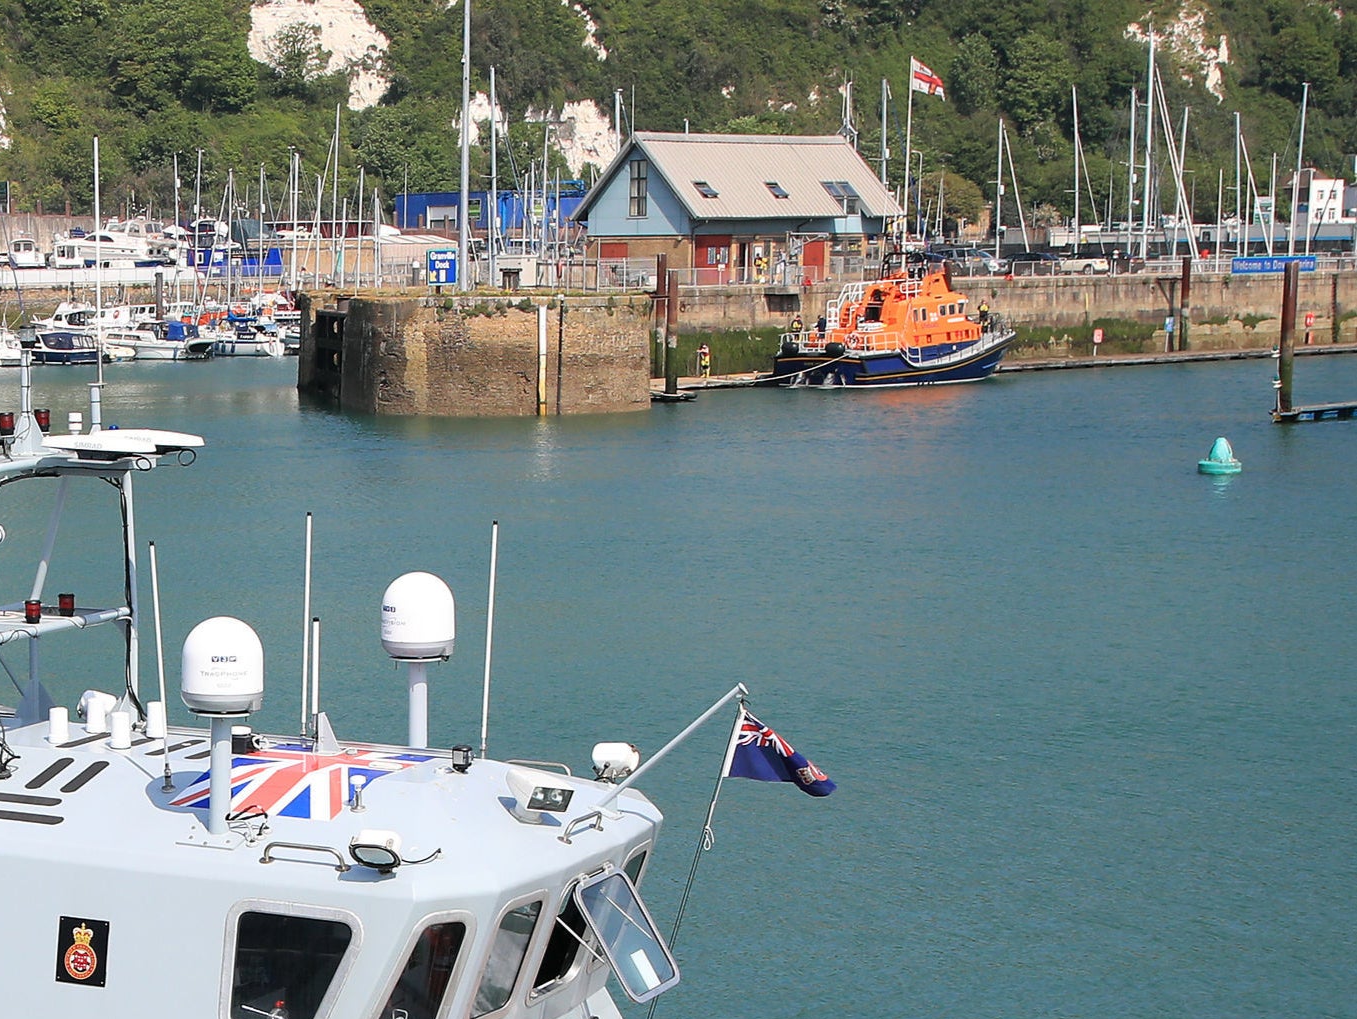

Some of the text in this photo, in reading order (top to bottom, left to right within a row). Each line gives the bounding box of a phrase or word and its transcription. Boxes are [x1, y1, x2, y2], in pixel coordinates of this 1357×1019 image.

[430, 251, 455, 260] Granville
[435, 260, 450, 269] Dock
[1233, 259, 1262, 270] Welcome
[1264, 260, 1271, 269] to
